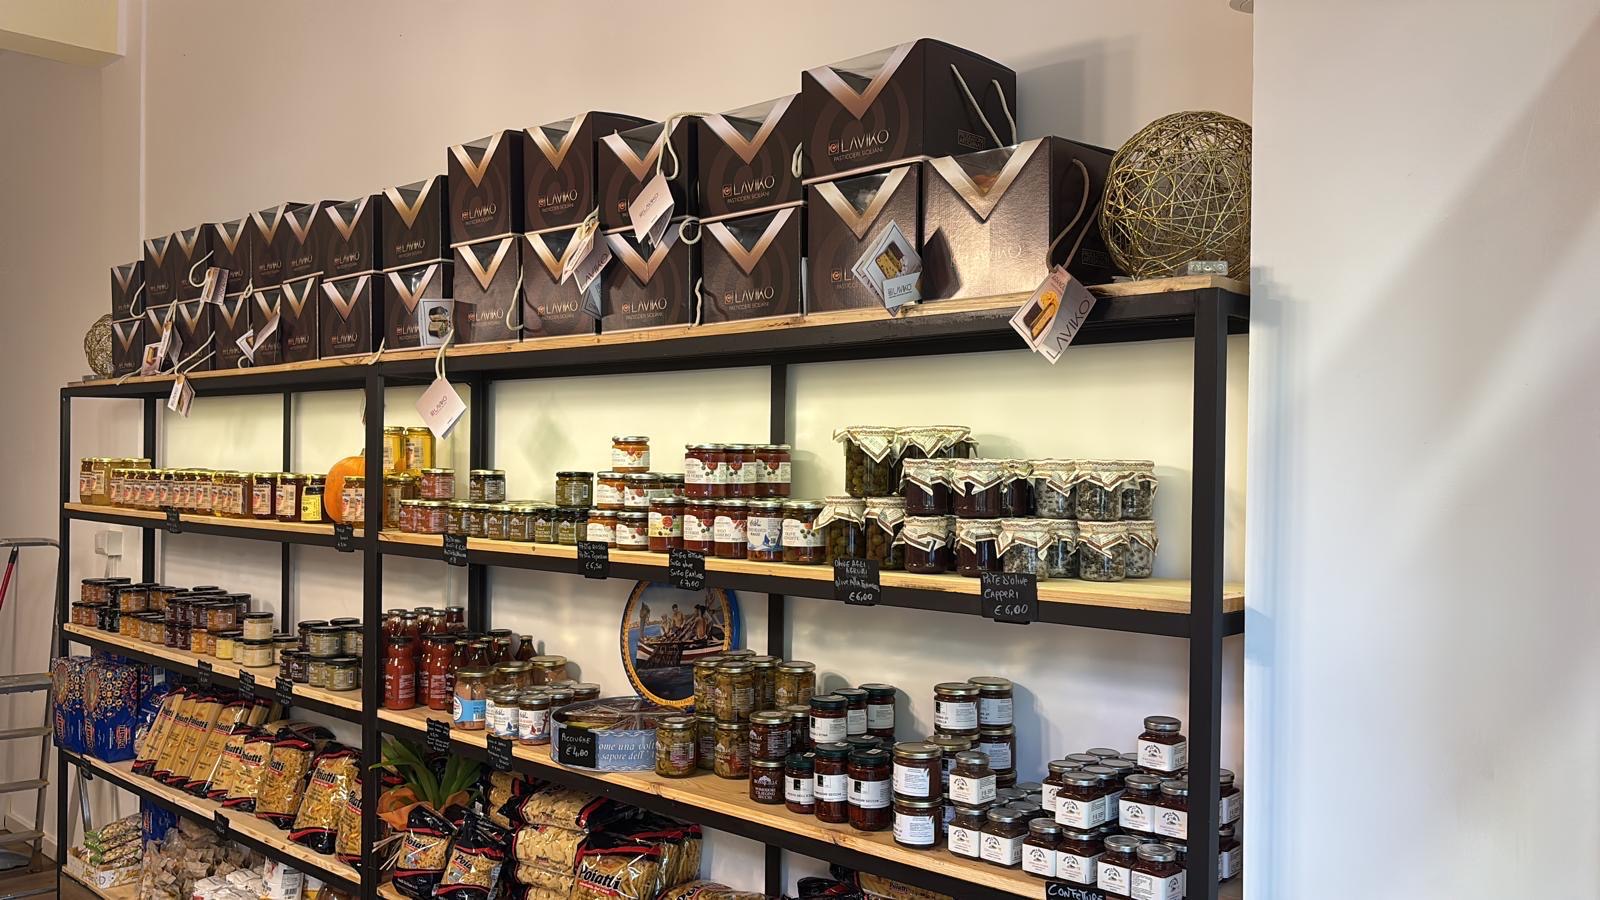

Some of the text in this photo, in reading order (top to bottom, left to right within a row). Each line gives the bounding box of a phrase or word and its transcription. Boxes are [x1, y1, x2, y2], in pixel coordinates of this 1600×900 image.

[841, 129, 889, 153] LAVIKO
[733, 175, 775, 196] LAVIKO
[546, 189, 578, 206] LAVIKO
[469, 203, 497, 219] LAVIKO
[402, 239, 426, 254] LAVIKO
[734, 287, 775, 304] LAVIKO
[545, 300, 579, 315] LAVIKO
[630, 298, 668, 313] LAVIKO
[476, 308, 504, 321] LAVIKO
[1046, 300, 1090, 359] LAVIKO
[598, 742, 617, 751] ome
[618, 741, 635, 751] una
[601, 751, 627, 763] sapore
[315, 767, 336, 784] Poiatti
[580, 865, 622, 890] Poiatti
